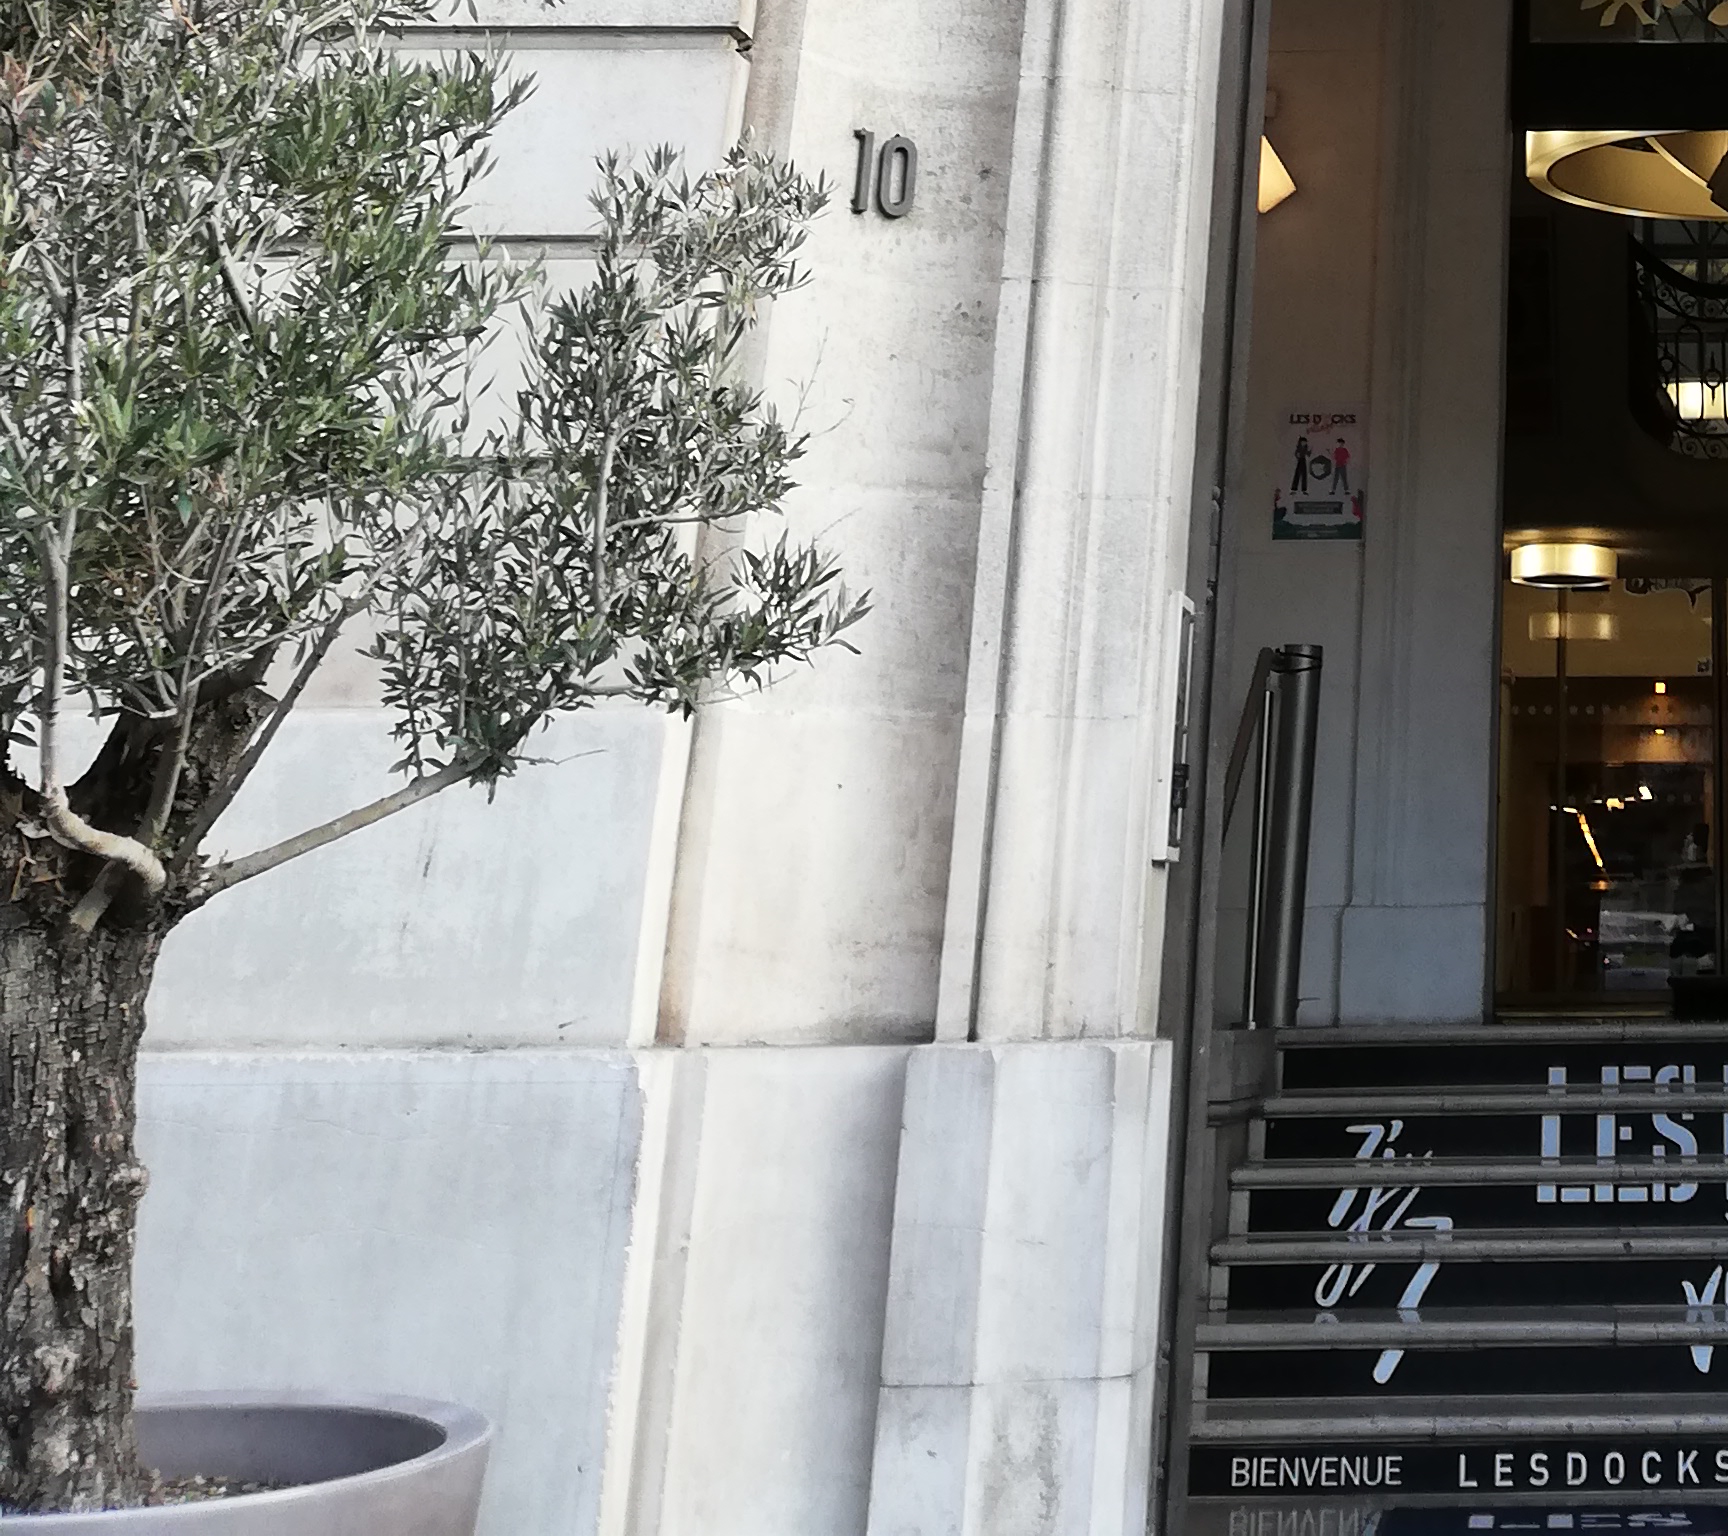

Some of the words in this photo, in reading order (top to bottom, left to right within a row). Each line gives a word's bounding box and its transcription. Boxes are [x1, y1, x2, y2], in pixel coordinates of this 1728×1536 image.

[851, 127, 918, 220] 10
[1313, 413, 1356, 425] DCKS
[1537, 1065, 1698, 1203] LES
[1230, 1455, 1402, 1487] BIENVENUE
